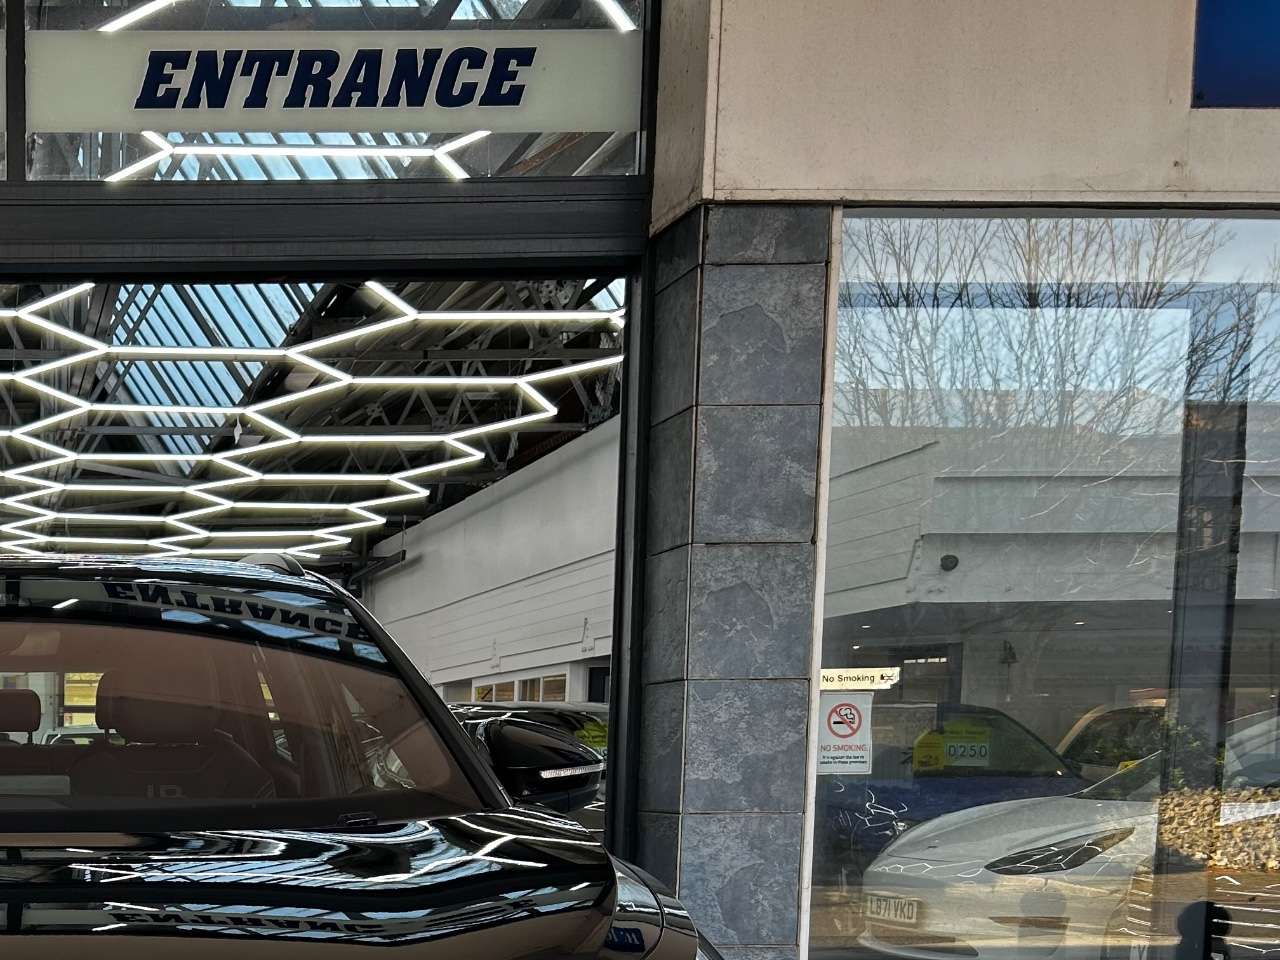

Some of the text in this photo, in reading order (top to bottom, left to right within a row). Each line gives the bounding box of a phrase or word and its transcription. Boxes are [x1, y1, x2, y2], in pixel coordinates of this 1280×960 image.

[134, 46, 537, 109] ENTRANCE
[821, 673, 875, 685] No Smoking
[820, 744, 832, 752] NO
